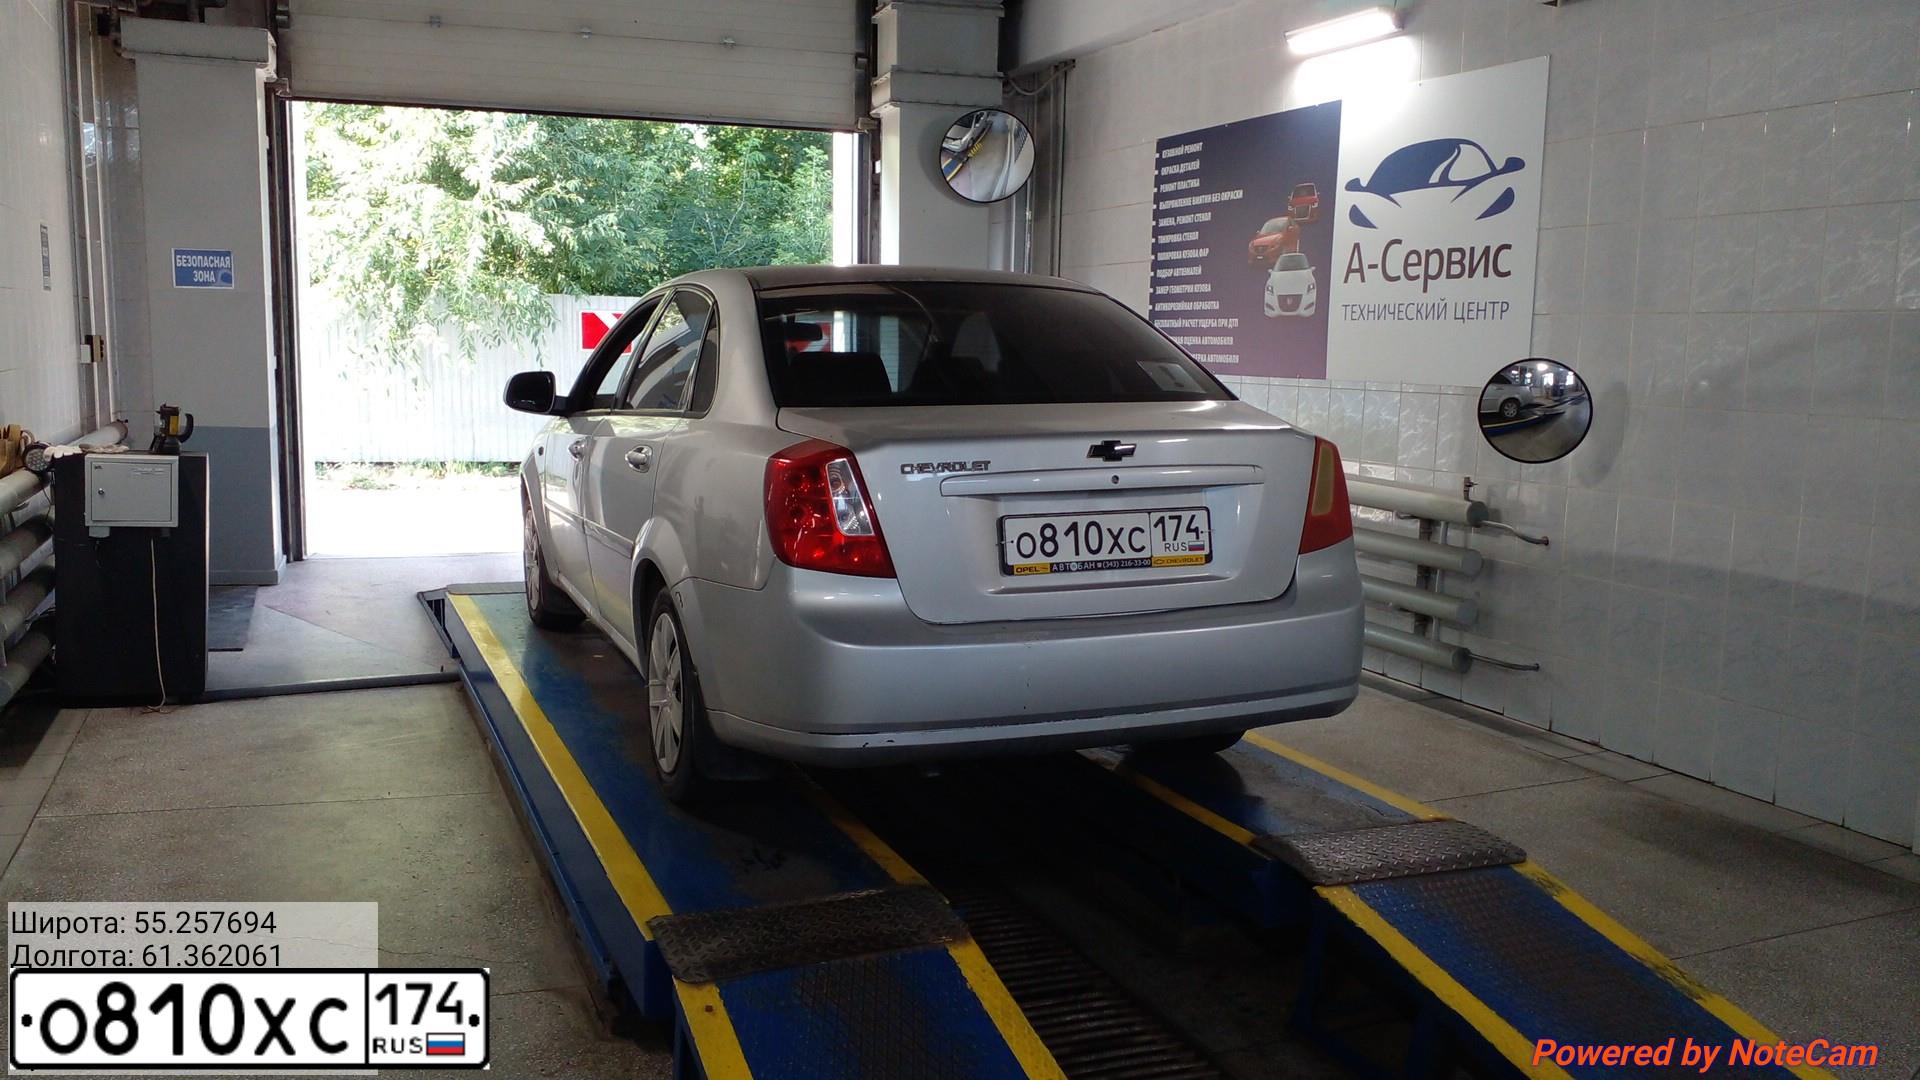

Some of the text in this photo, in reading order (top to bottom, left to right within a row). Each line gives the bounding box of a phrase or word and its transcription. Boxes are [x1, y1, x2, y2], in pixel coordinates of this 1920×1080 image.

[1184, 142, 1203, 154] РЕМОНТ
[1161, 159, 1200, 175] ОКРАСКА ДЕТАЛЕЙ
[1160, 178, 1200, 193] РЕМОНТ ПЛАСТИКА
[1212, 192, 1221, 202] БЕЗ
[1221, 189, 1243, 201] ОКРАСКИ
[1176, 213, 1194, 225] РЕМОНТ
[1194, 211, 1212, 223] СТЕКОЛ
[1158, 231, 1199, 244] ТОНИРОВКА СТЕКОЛ
[176, 255, 231, 268] БЕЗОПАСНАЯ
[1343, 239, 1513, 293] А-Сервис
[193, 270, 216, 283] ЗОНА
[1156, 268, 1173, 279] ПОДБОР
[1193, 301, 1220, 310] ОБРАБОТКА
[1342, 297, 1510, 323] ТЕХНИЧЕСКИЙ ЦЕНТР
[1198, 318, 1217, 328] УЩЕРБА
[1218, 318, 1228, 327] ПРИ
[1228, 318, 1239, 329] ДТП
[1184, 336, 1201, 346] ОЦЕНКА
[1202, 336, 1234, 345] АВТОМОБИЛЯ
[1207, 354, 1240, 364] АВТОМОБИЛЯ
[901, 460, 991, 475] CHEVROLET
[1153, 514, 1200, 542] 174
[1164, 541, 1188, 553] RUS
[1052, 561, 1096, 572] АВТОБАН
[1166, 556, 1204, 565] CHEVROLET
[1015, 566, 1040, 574] OPEL
